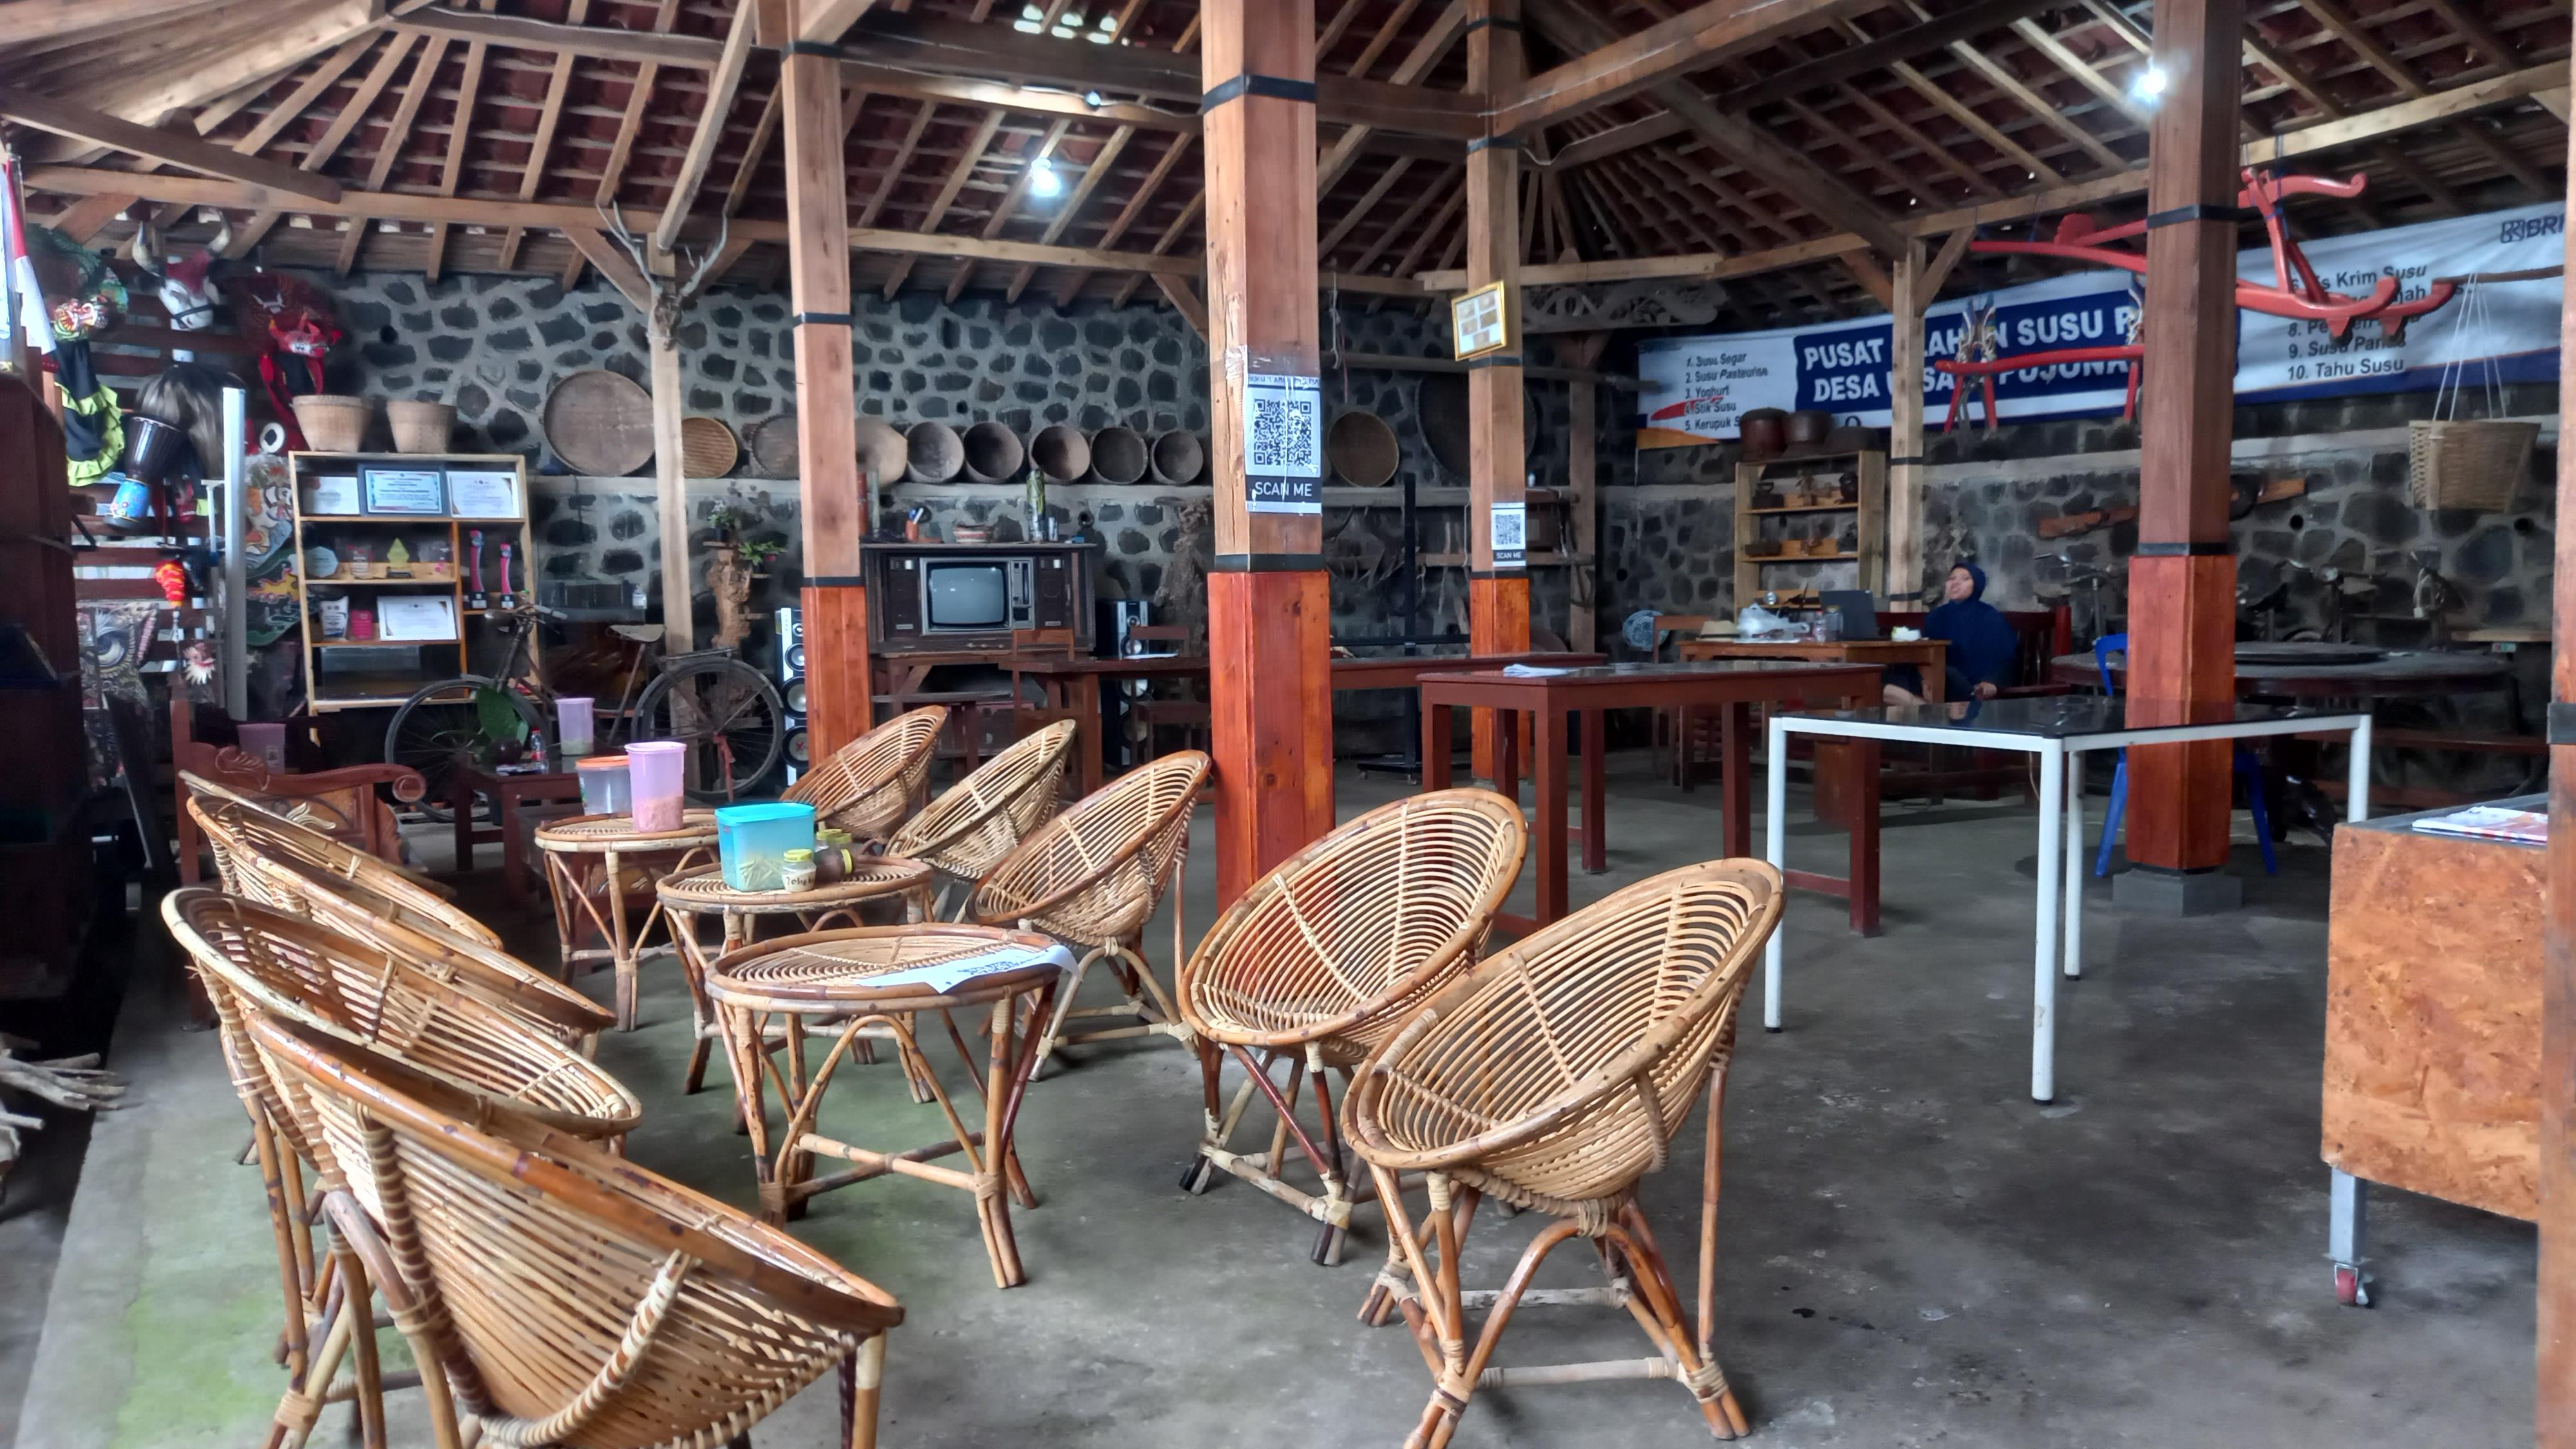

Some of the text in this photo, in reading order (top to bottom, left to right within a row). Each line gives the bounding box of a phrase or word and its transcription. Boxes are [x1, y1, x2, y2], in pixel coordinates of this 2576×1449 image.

[2336, 270, 2376, 288] Krim
[1804, 337, 1884, 371] PUSAT
[2017, 308, 2104, 346] SUSU
[2289, 343, 2302, 359] 9.
[1696, 356, 1718, 367] Susu
[1719, 353, 1747, 366] Segar
[1695, 371, 1718, 382] Susu
[1719, 366, 1768, 379] Pasteurise
[2288, 358, 2404, 381] 10. Tahu Susu
[1695, 385, 1730, 399] Yoghurt
[1814, 374, 1880, 402] DESA
[1694, 401, 1710, 413] Stik
[1714, 401, 1737, 412] Susu
[1695, 417, 1730, 431] Kerupuk
[1255, 482, 1312, 497] SCAN ME
